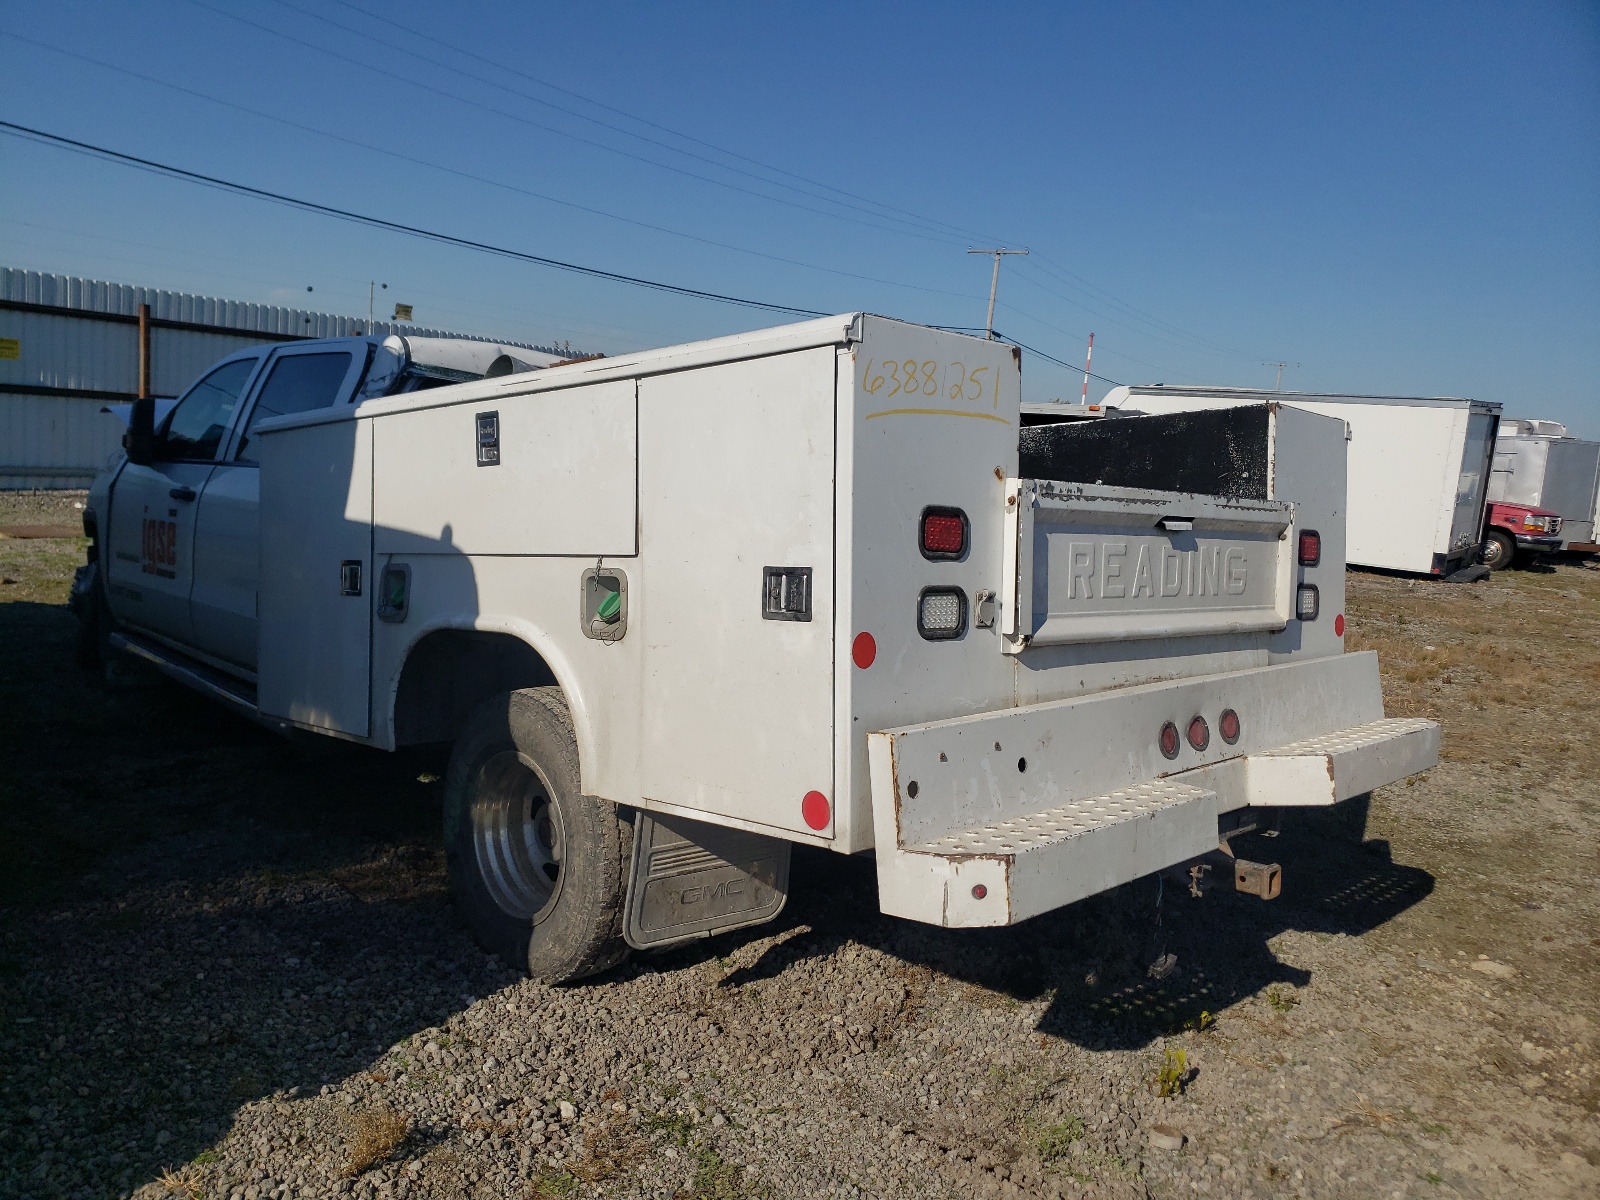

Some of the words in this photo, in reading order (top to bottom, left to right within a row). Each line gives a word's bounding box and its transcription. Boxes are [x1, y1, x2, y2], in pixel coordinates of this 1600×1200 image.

[862, 357, 1001, 410] 63881251
[1067, 541, 1248, 599] READING
[680, 878, 745, 905] GMC
